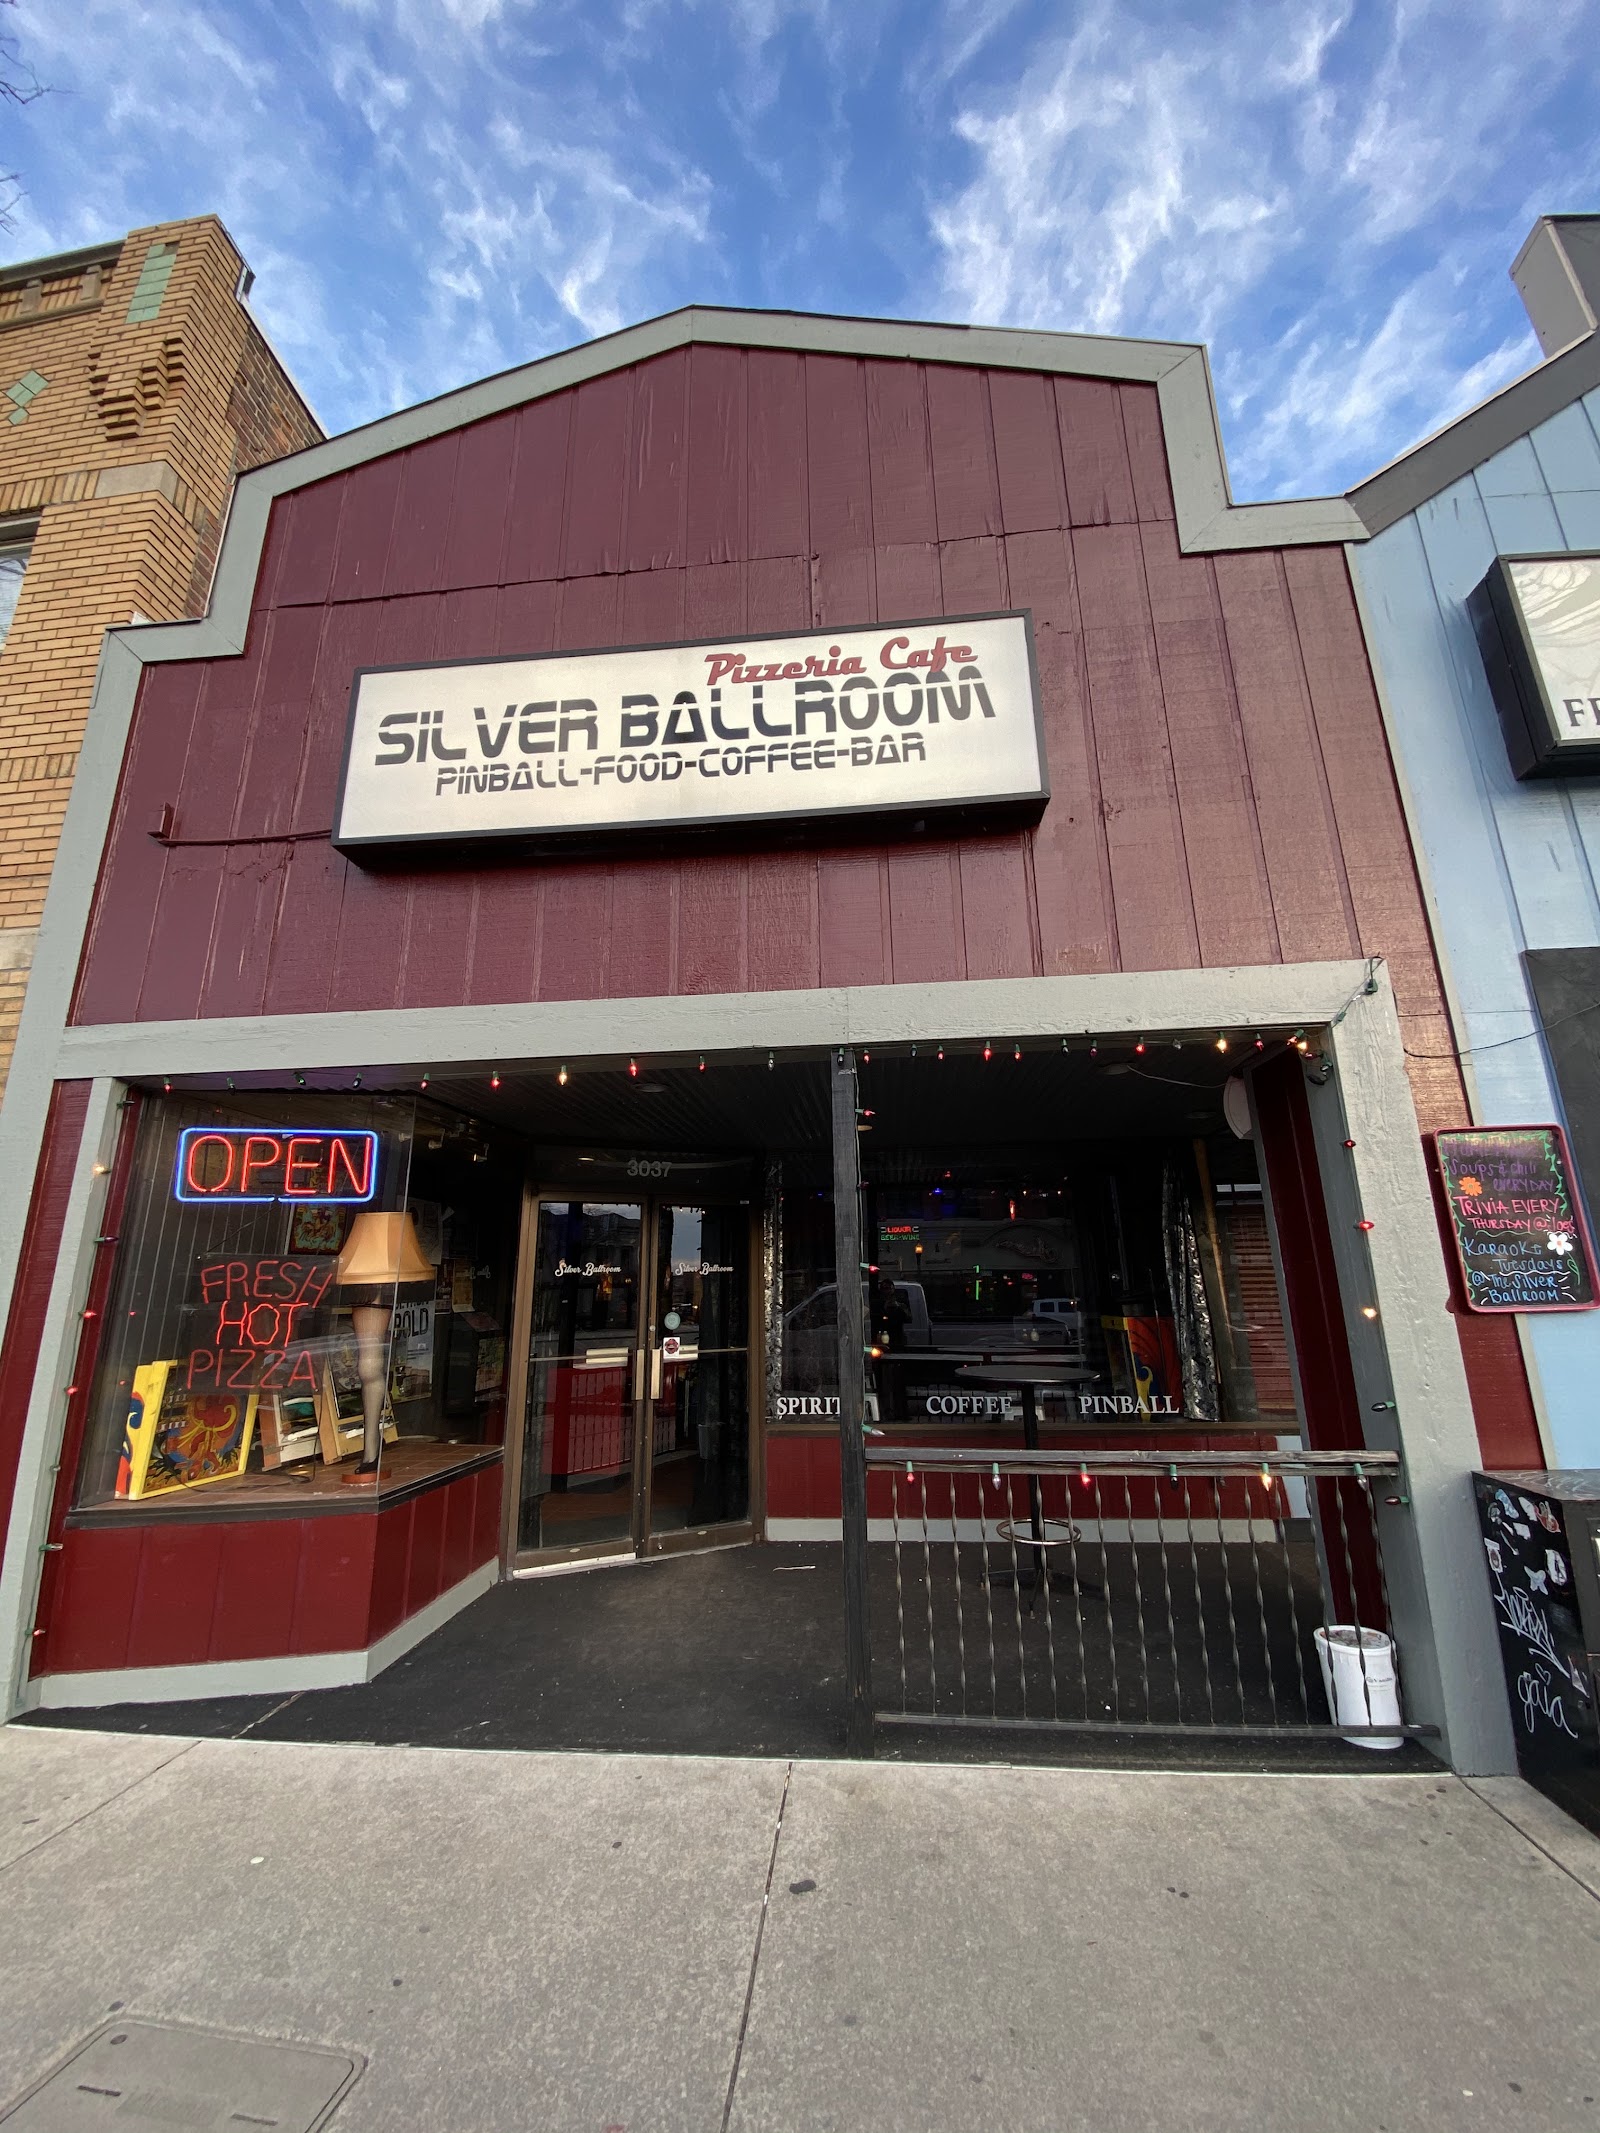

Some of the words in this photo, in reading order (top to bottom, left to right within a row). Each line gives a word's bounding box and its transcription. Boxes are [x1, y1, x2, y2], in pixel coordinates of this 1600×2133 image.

[704, 645, 867, 686] Pizzeria
[880, 636, 979, 673] Cafe
[374, 697, 598, 766] SILVER
[620, 665, 996, 748] BALLROOM
[435, 732, 926, 796] PINBALL-FOOD-COFFEE-BAR
[187, 1135, 372, 1194] OPEN
[626, 1160, 673, 1178] 3037
[1511, 1198, 1559, 1214] EVERY
[1467, 1217, 1531, 1233] THURSDAY
[555, 1262, 582, 1277] Silver
[582, 1263, 622, 1277] Ballroom
[675, 1262, 699, 1276] Silver
[699, 1262, 734, 1276] Ballroom
[200, 1260, 333, 1309] FRESH
[216, 1301, 309, 1347] HOT
[187, 1349, 318, 1390] PIZZA
[776, 1396, 841, 1416] SPIRIT
[926, 1396, 1013, 1415] COFFEE
[1079, 1395, 1180, 1415] PINBALL
